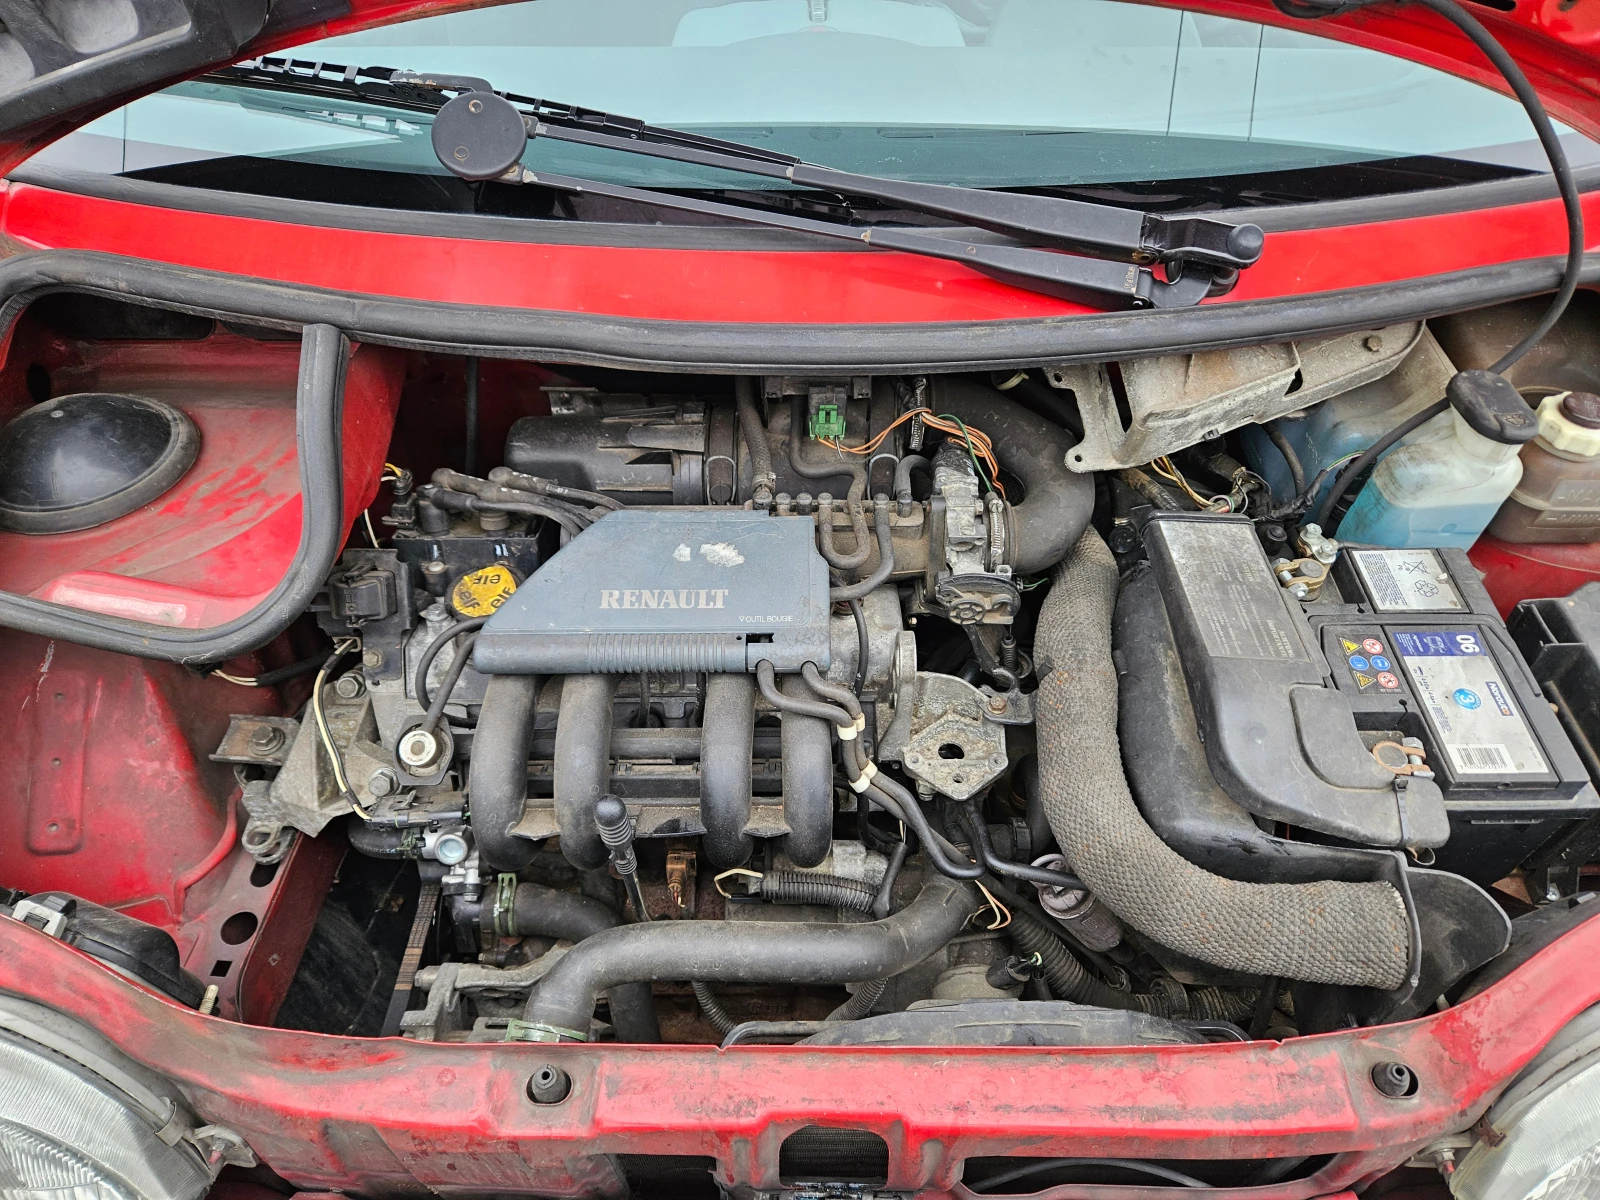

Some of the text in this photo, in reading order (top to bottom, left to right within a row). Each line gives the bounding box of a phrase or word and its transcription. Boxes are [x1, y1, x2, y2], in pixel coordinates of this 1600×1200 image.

[472, 573, 501, 585] elf
[598, 588, 729, 609] RENAULT
[745, 614, 794, 623] OUTIL BOUGIE
[1455, 634, 1480, 653] 06
[1459, 694, 1476, 703] 3
[1488, 682, 1511, 715] Norauto
